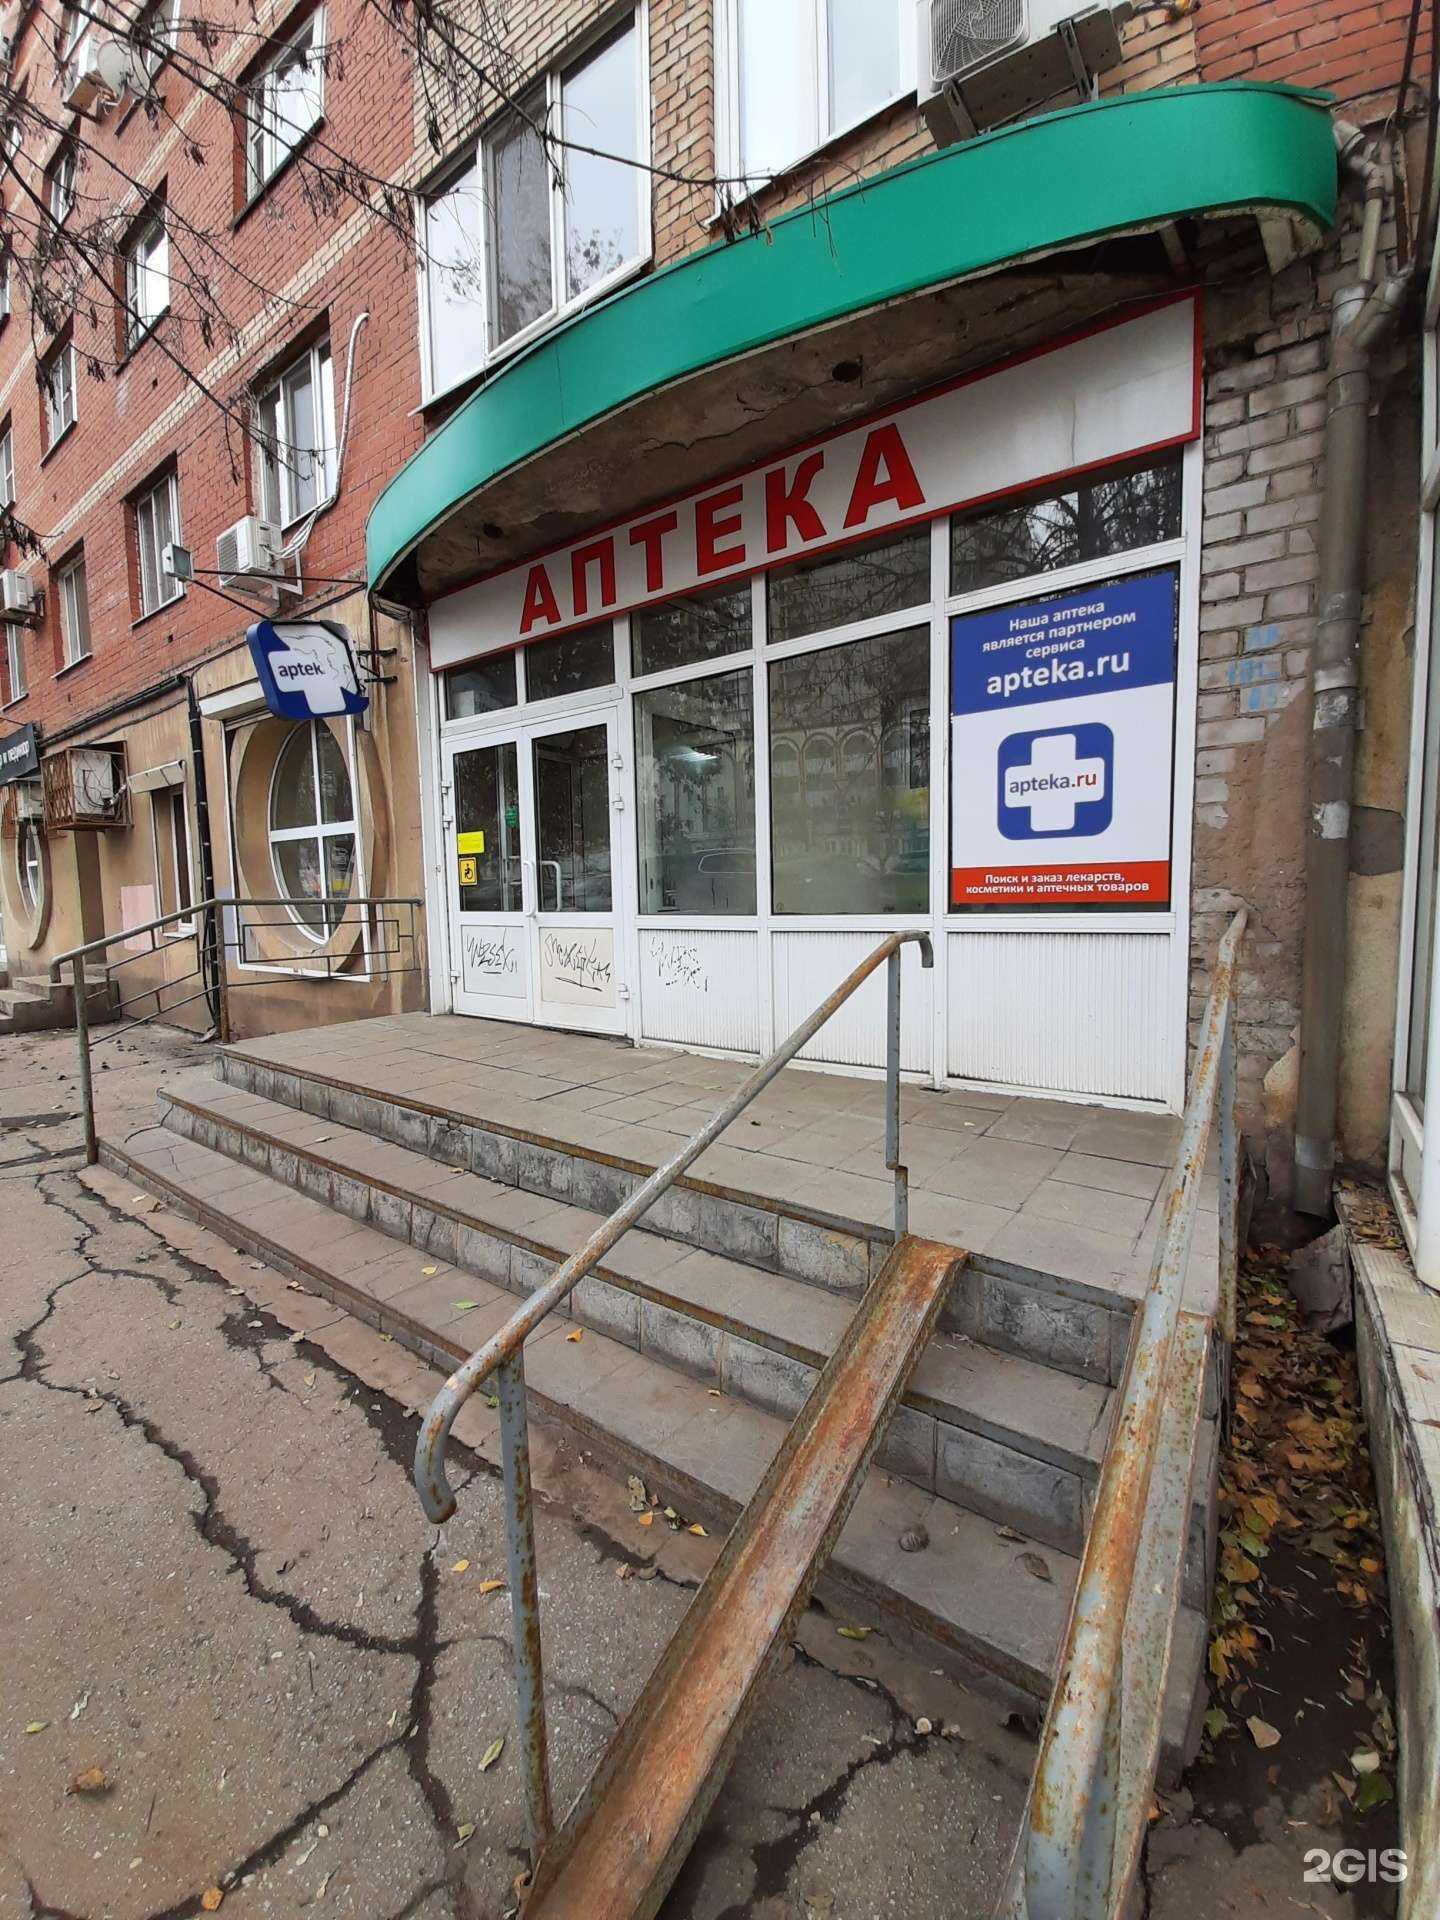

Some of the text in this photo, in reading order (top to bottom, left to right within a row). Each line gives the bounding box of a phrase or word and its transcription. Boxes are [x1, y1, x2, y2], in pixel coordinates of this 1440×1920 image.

[518, 422, 926, 634] АПТЕКА
[1009, 601, 1105, 632] Наша аптека
[982, 611, 1137, 653] является партнером
[1025, 638, 1086, 659] сервиса
[986, 651, 1130, 698] apteka.ru
[1009, 773, 1097, 796] apteka.ru
[966, 882, 1150, 894] косметики и аптечных товаров
[985, 872, 1125, 884] Поиск и заказ лекарств,
